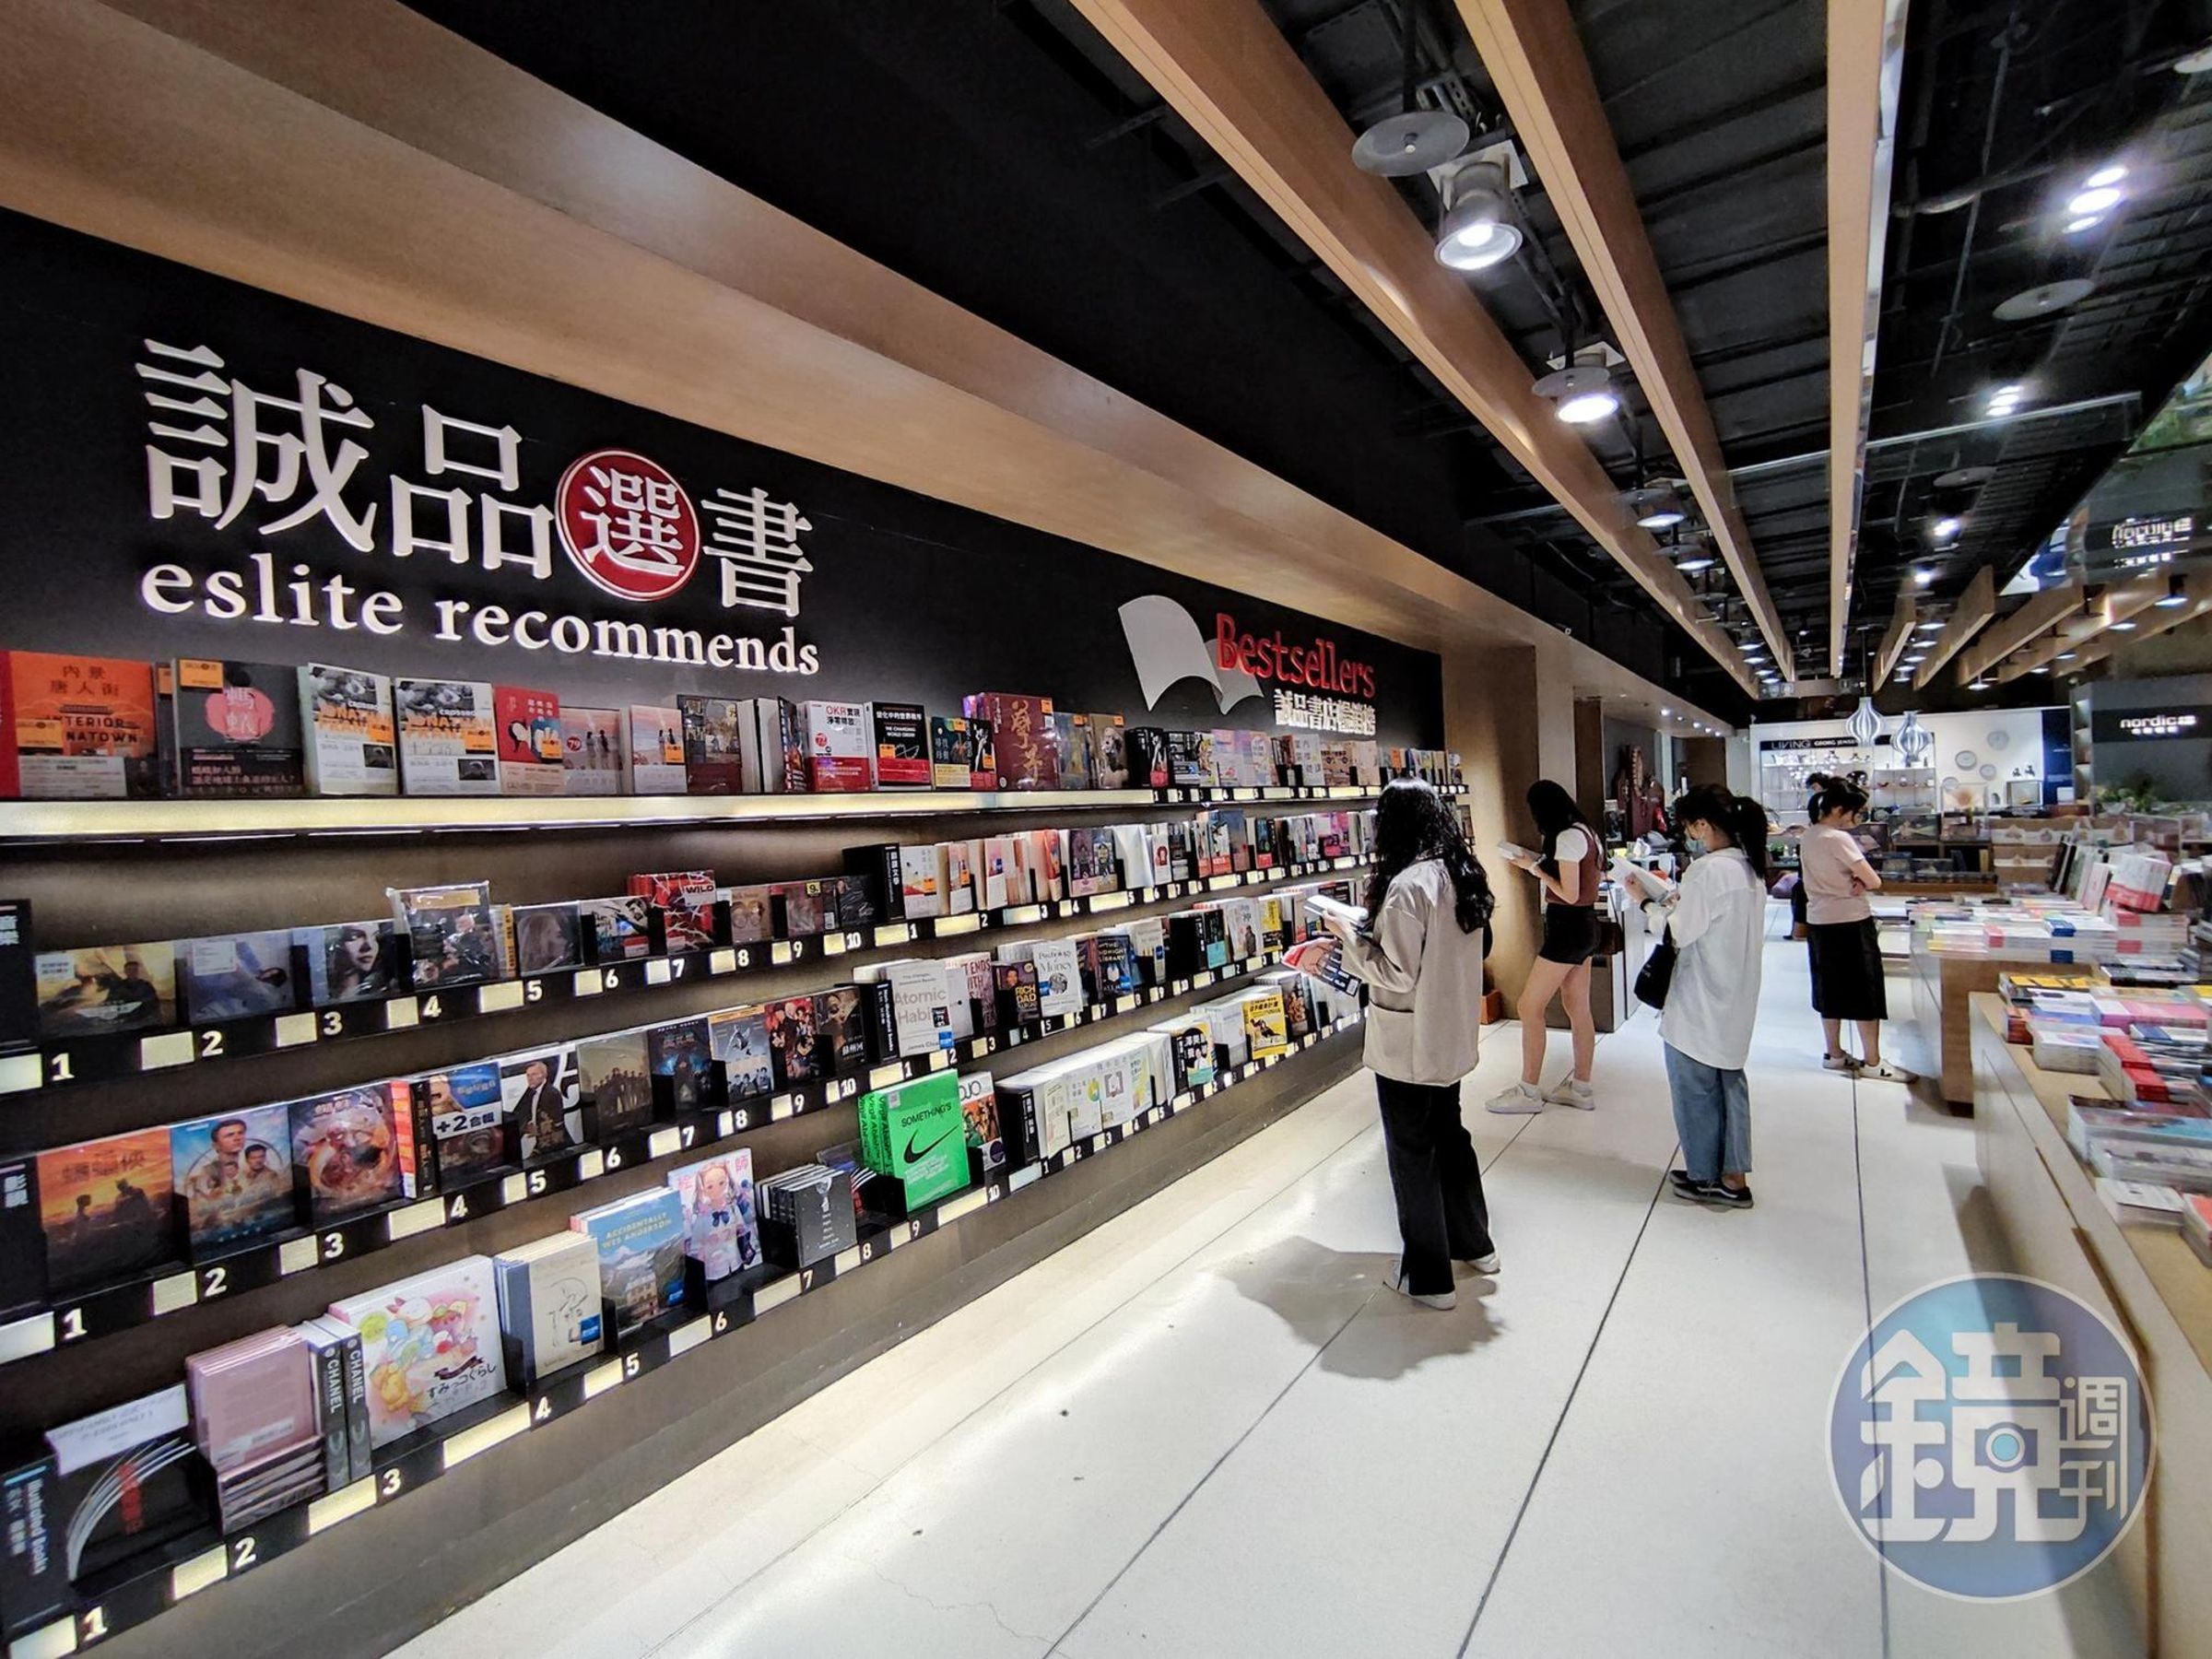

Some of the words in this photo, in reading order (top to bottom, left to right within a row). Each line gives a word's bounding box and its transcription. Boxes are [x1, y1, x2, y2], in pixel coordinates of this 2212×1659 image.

[135, 337, 813, 618] 誠品選書
[141, 553, 404, 635] eslite
[434, 599, 820, 676] recommends
[1216, 612, 1376, 699] Bestsellers
[2120, 714, 2177, 728] nordic
[1771, 739, 1811, 750] LIVING
[1072, 898, 1080, 913] 4
[1128, 889, 1135, 904] 5
[981, 913, 989, 927] 2
[1041, 904, 1049, 919] 3
[846, 932, 862, 949] 10
[910, 924, 918, 939] 1
[738, 949, 749, 967] 8
[794, 941, 803, 958] 9
[672, 959, 685, 978] 7
[606, 969, 619, 988] 6
[527, 980, 543, 1002] 5
[894, 989, 947, 1006] Atomic
[1016, 984, 1036, 996] RICH
[1016, 994, 1037, 1004] DAD
[423, 994, 442, 1018] 4
[1135, 994, 1142, 1006] 8
[324, 1011, 343, 1036] 3
[898, 1010, 932, 1025] Habi
[1046, 1019, 1052, 1030] 5
[202, 1030, 224, 1056] 2
[925, 1040, 940, 1048] Clea
[989, 1037, 996, 1051] 3
[949, 1048, 958, 1064] 2
[52, 1053, 75, 1081] 1
[904, 1062, 912, 1077] 1
[841, 1077, 856, 1095] 10
[794, 1094, 805, 1112] 9
[1159, 1106, 1165, 1118] 5
[736, 1111, 747, 1128] 8
[1134, 1119, 1139, 1131] 4
[682, 1126, 694, 1147] 7
[1106, 1132, 1112, 1145] 3
[606, 1147, 620, 1168] 6
[1076, 1146, 1082, 1159] 2
[1042, 1161, 1049, 1174] 1
[530, 1171, 546, 1192] 5
[988, 1184, 1000, 1202] 10
[452, 1194, 468, 1219] 4
[912, 1219, 920, 1237] 9
[324, 1231, 344, 1258] 3
[863, 1242, 872, 1260] 8
[205, 1267, 227, 1297] 2
[803, 1269, 813, 1289] 7
[63, 1307, 88, 1340] 1
[715, 1312, 727, 1332] 6
[626, 1355, 640, 1376] 5
[349, 1349, 364, 1405] CHANEL
[327, 1359, 343, 1414] CHANEL
[535, 1397, 551, 1419] 4
[382, 1468, 401, 1494] 3
[235, 1536, 256, 1568] 2
[83, 1606, 108, 1640] 1
